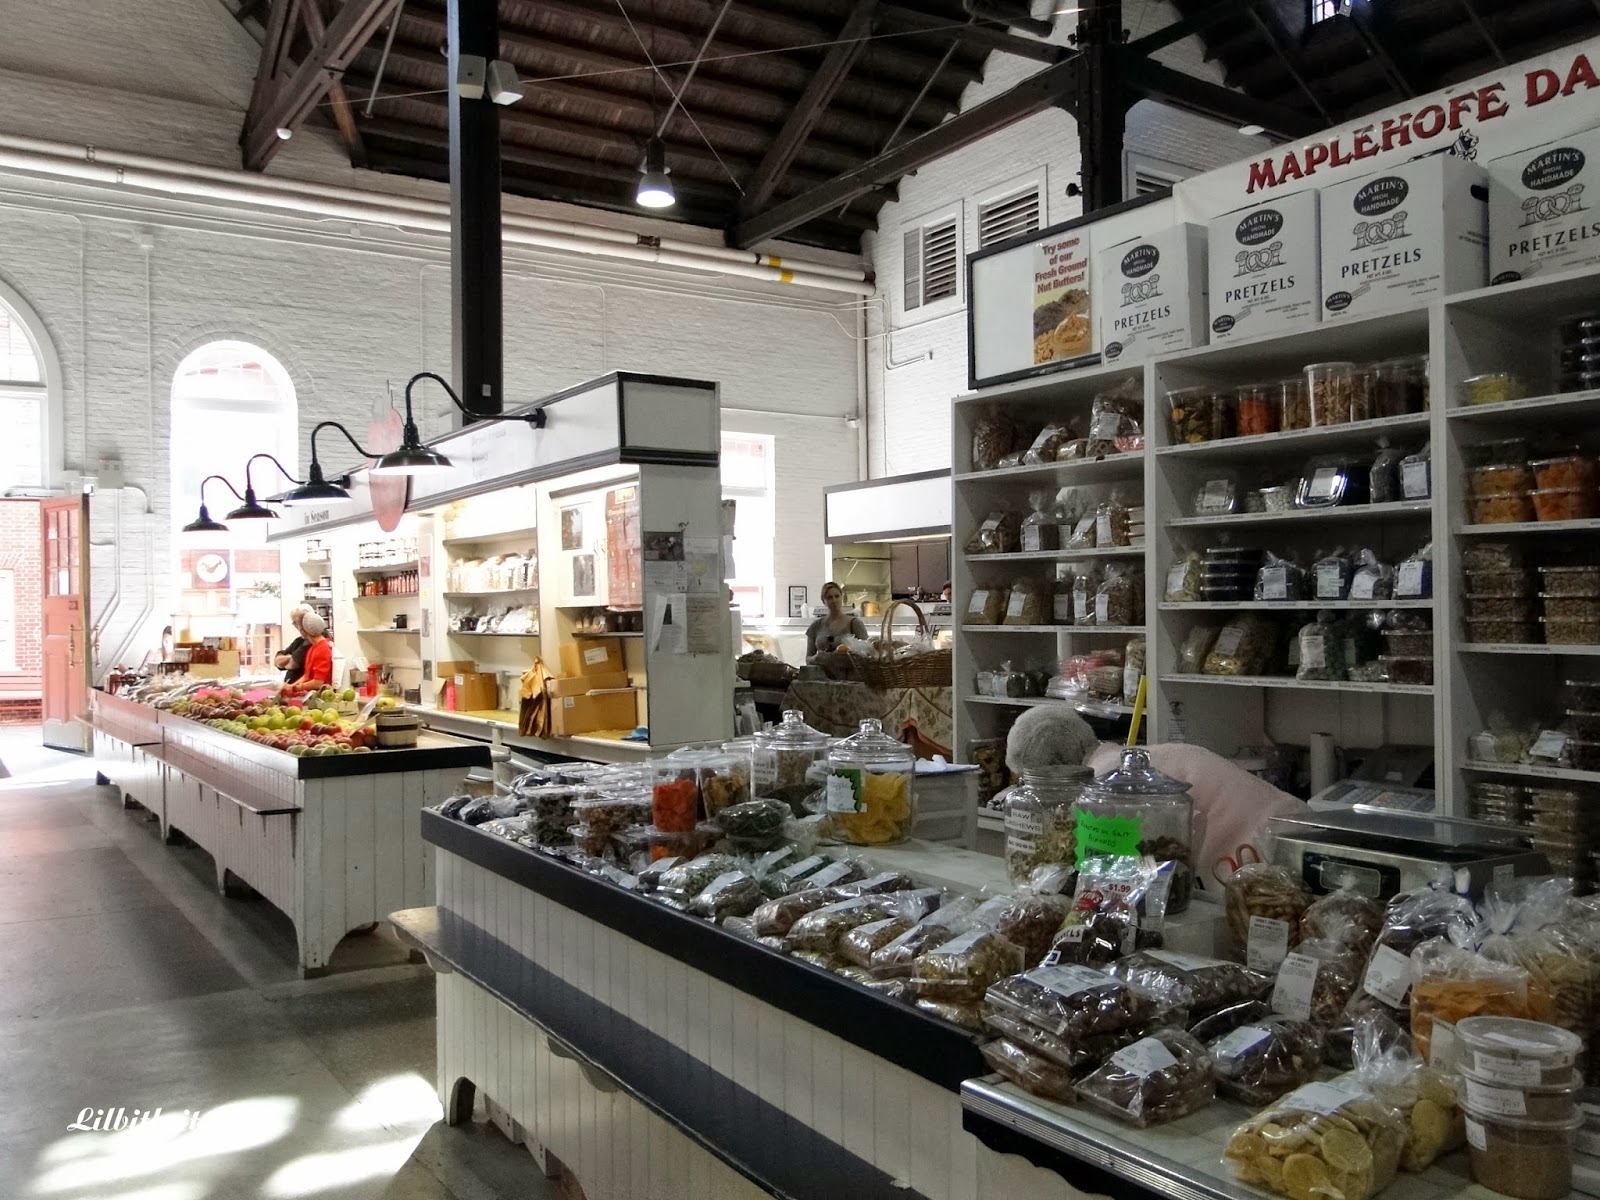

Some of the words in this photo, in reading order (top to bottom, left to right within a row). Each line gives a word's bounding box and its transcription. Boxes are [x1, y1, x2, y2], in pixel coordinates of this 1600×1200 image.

[1246, 82, 1510, 194] MAPLEHOFE
[1524, 53, 1600, 108] DA
[1527, 152, 1581, 175] MARTIN'S
[1530, 169, 1574, 187] HANDMADE
[1358, 181, 1404, 201] MARTIN'S
[1361, 197, 1400, 213] HANDMADE
[1239, 213, 1280, 232] MARTIN'S
[1242, 228, 1275, 243] HANDMADE
[1509, 222, 1600, 257] PRETZELS
[1042, 245, 1056, 255] Try
[1057, 237, 1080, 250] some
[1049, 254, 1058, 265] of
[1059, 252, 1073, 262] our
[1123, 247, 1157, 265] MARTIN'S
[1341, 248, 1421, 278] PRETZELS
[1035, 268, 1057, 282] Fresh
[1058, 258, 1087, 275] Ground
[1037, 283, 1052, 294] Nut
[1053, 271, 1085, 290] Butters!
[1225, 275, 1295, 303] PRETZELS
[1114, 305, 1171, 331] PRETZELS
[1012, 811, 1030, 820] RAW
[1108, 883, 1131, 893] $1.99
